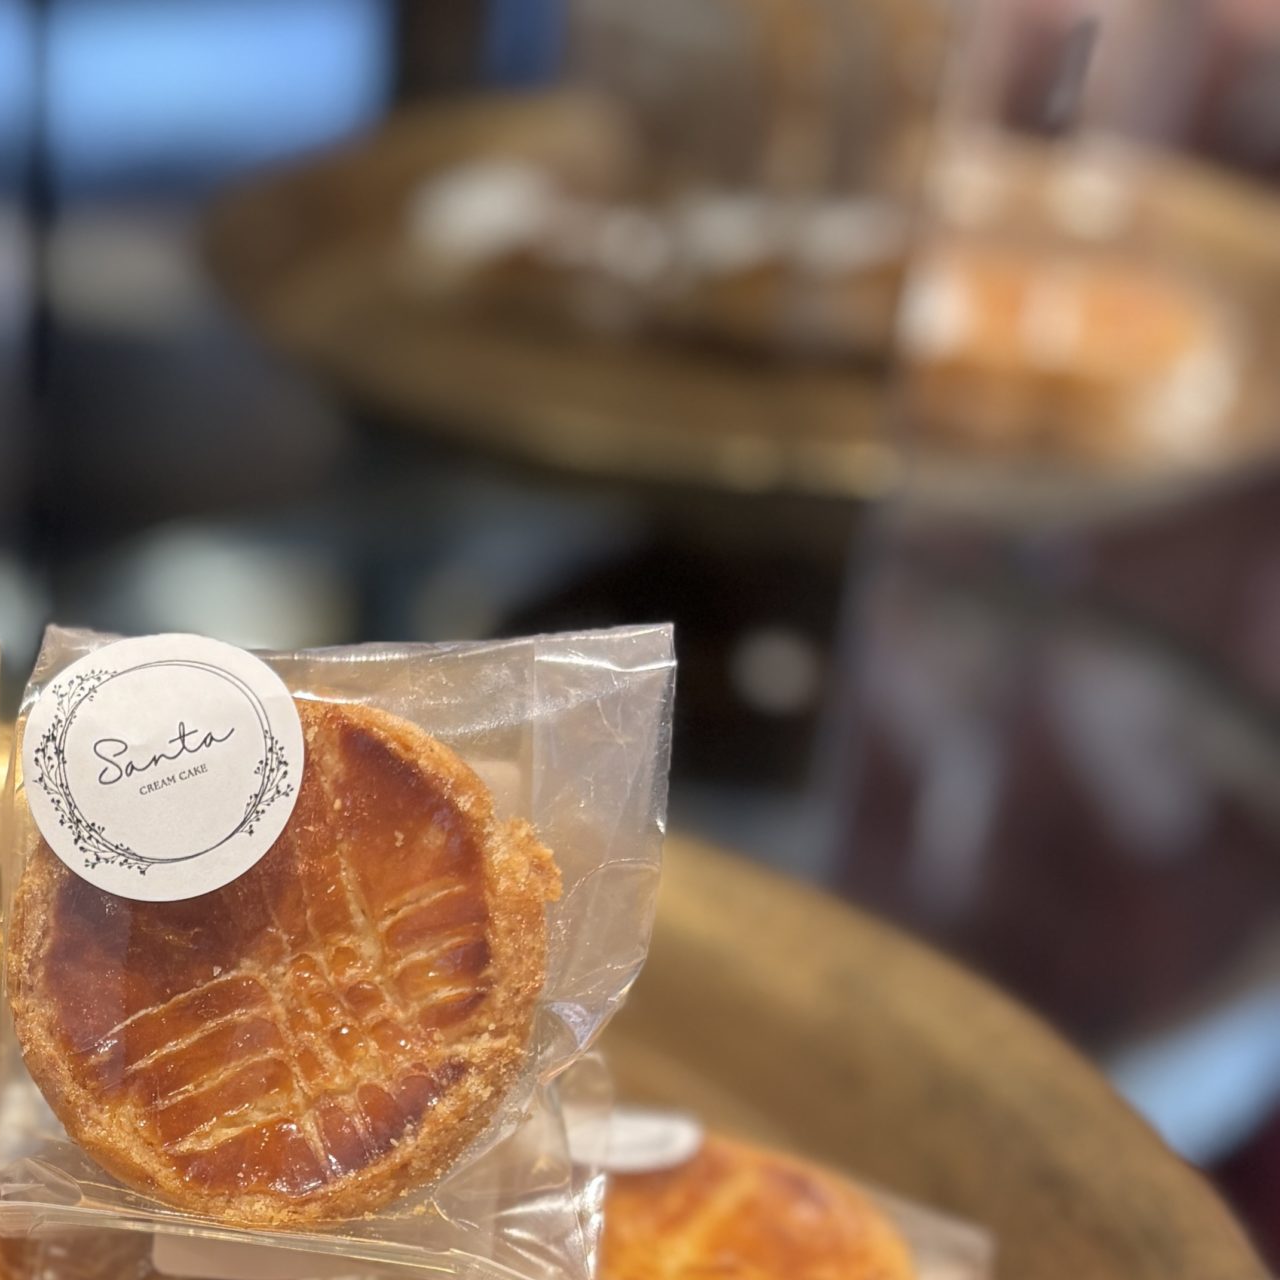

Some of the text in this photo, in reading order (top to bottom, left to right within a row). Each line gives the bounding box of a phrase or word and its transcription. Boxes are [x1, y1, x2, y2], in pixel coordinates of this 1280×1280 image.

[93, 721, 235, 785] Santa
[138, 763, 208, 796] CREAM CAKE
